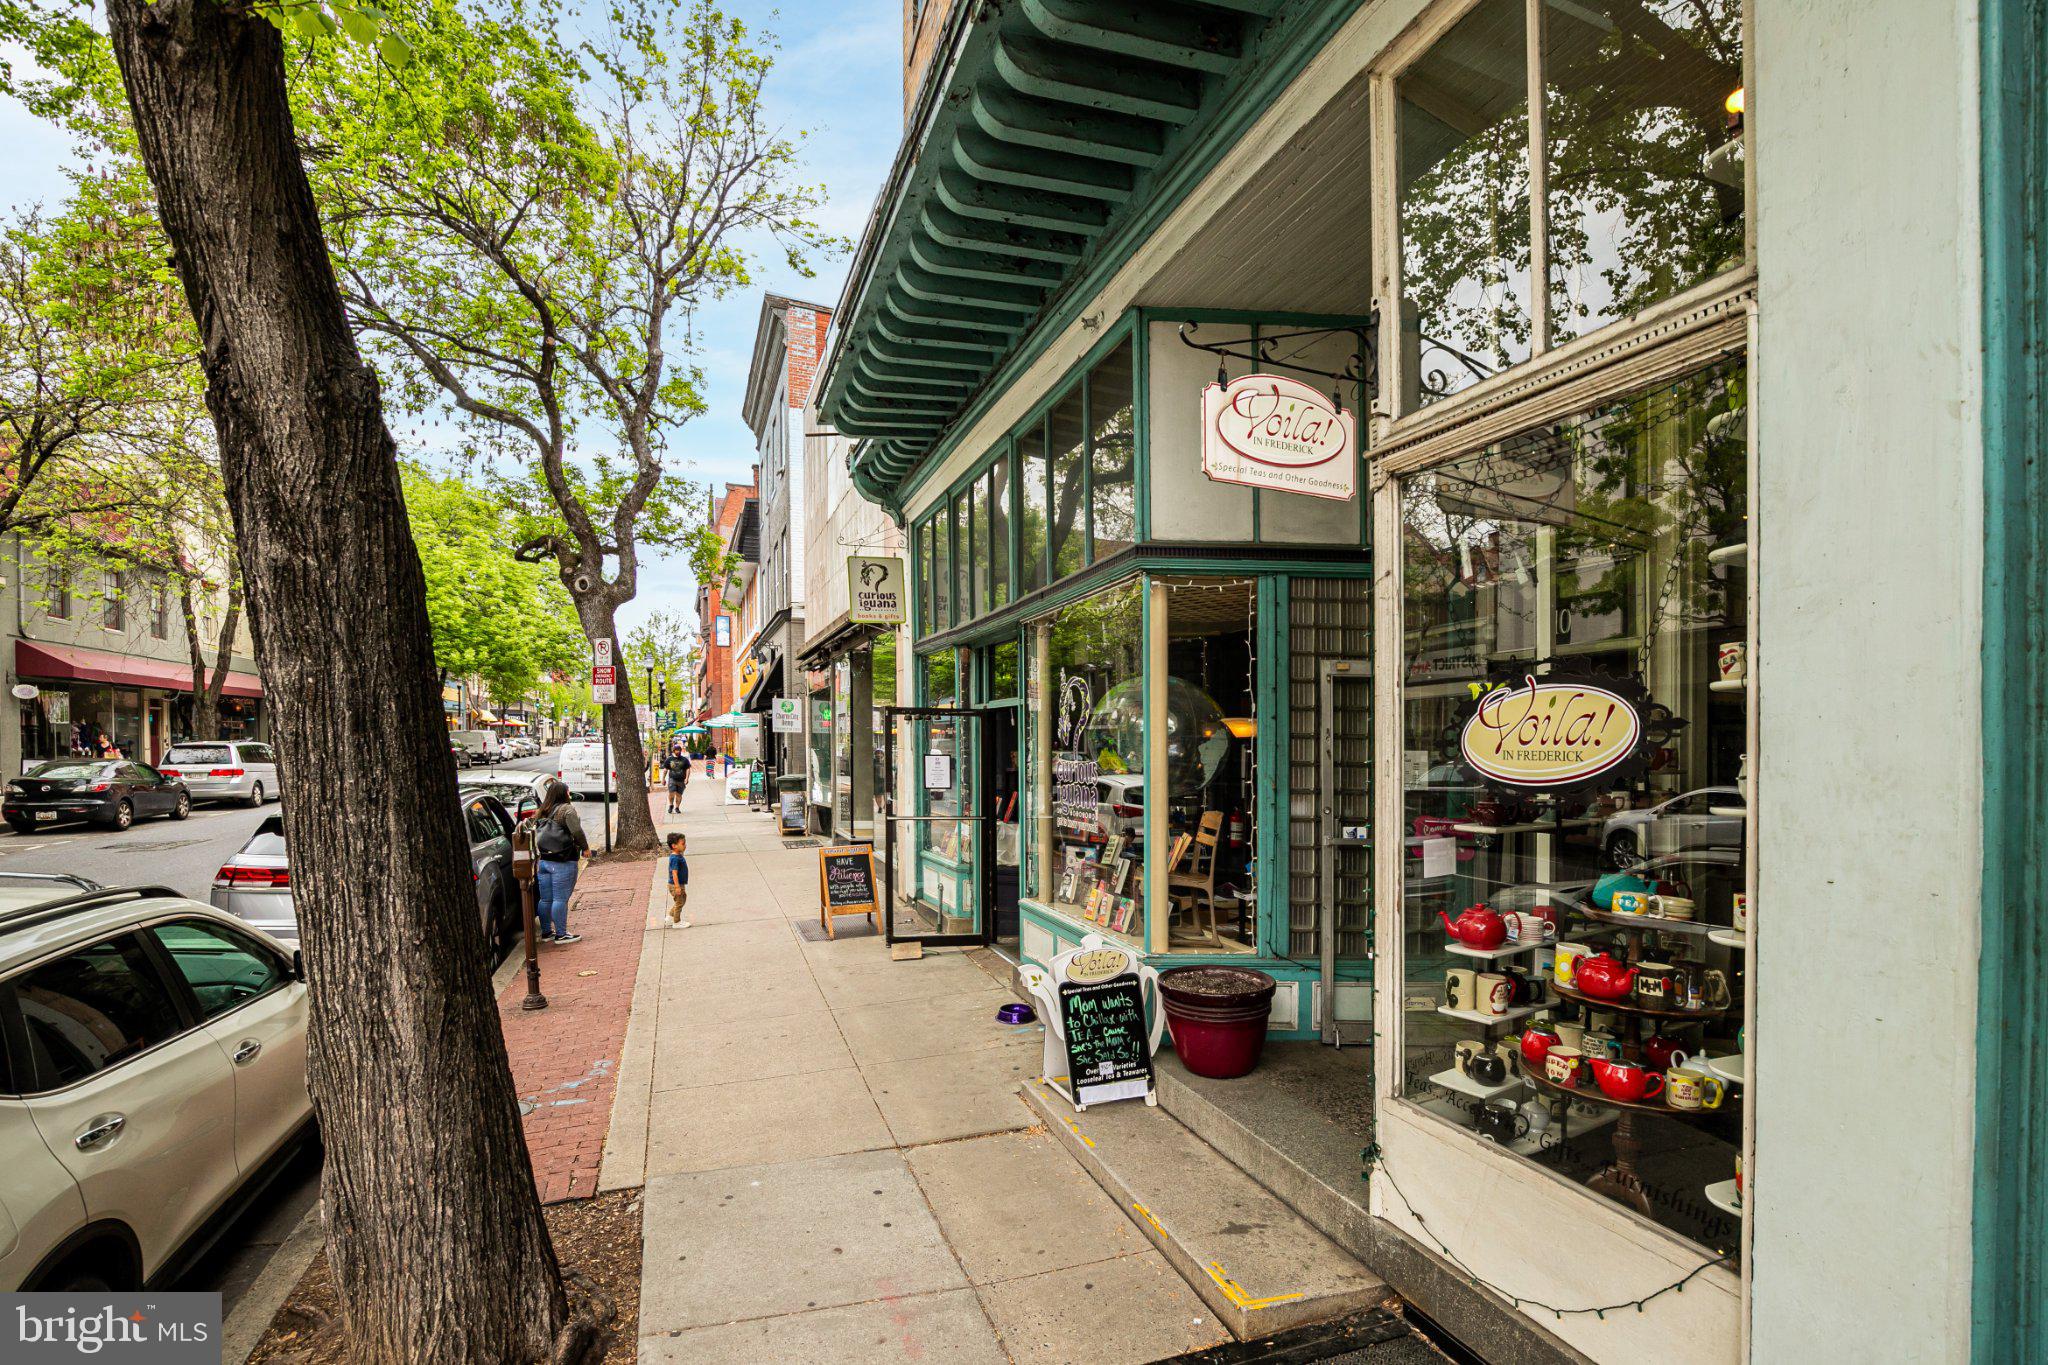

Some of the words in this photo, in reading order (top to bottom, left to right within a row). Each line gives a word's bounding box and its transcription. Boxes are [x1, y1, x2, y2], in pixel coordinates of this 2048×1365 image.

[1232, 384, 1333, 445] Voila!
[1253, 436, 1264, 447] IN
[1265, 439, 1314, 455] FREDERICK
[1218, 462, 1247, 475] Special
[1250, 467, 1267, 478] Teas
[1268, 471, 1283, 481] and
[1285, 473, 1307, 485] Other
[1308, 478, 1343, 490] Goodness
[858, 591, 897, 600] curious
[860, 599, 897, 611] iguana
[1478, 674, 1615, 755] Voila!
[1502, 750, 1516, 760] IN
[1517, 750, 1584, 762] FREDERICK
[1056, 761, 1098, 786] curious
[1056, 782, 1098, 815] iguana
[1069, 995, 1098, 1015] Mom
[1067, 1016, 1080, 1029] to
[1119, 1008, 1140, 1022] with
[1076, 1055, 1093, 1066] She
[1086, 1067, 1099, 1076] Over
[1112, 1062, 1137, 1071] Varieties
[1123, 1068, 1148, 1077] Teawares
[1601, 1164, 1732, 1239] Furnishings
